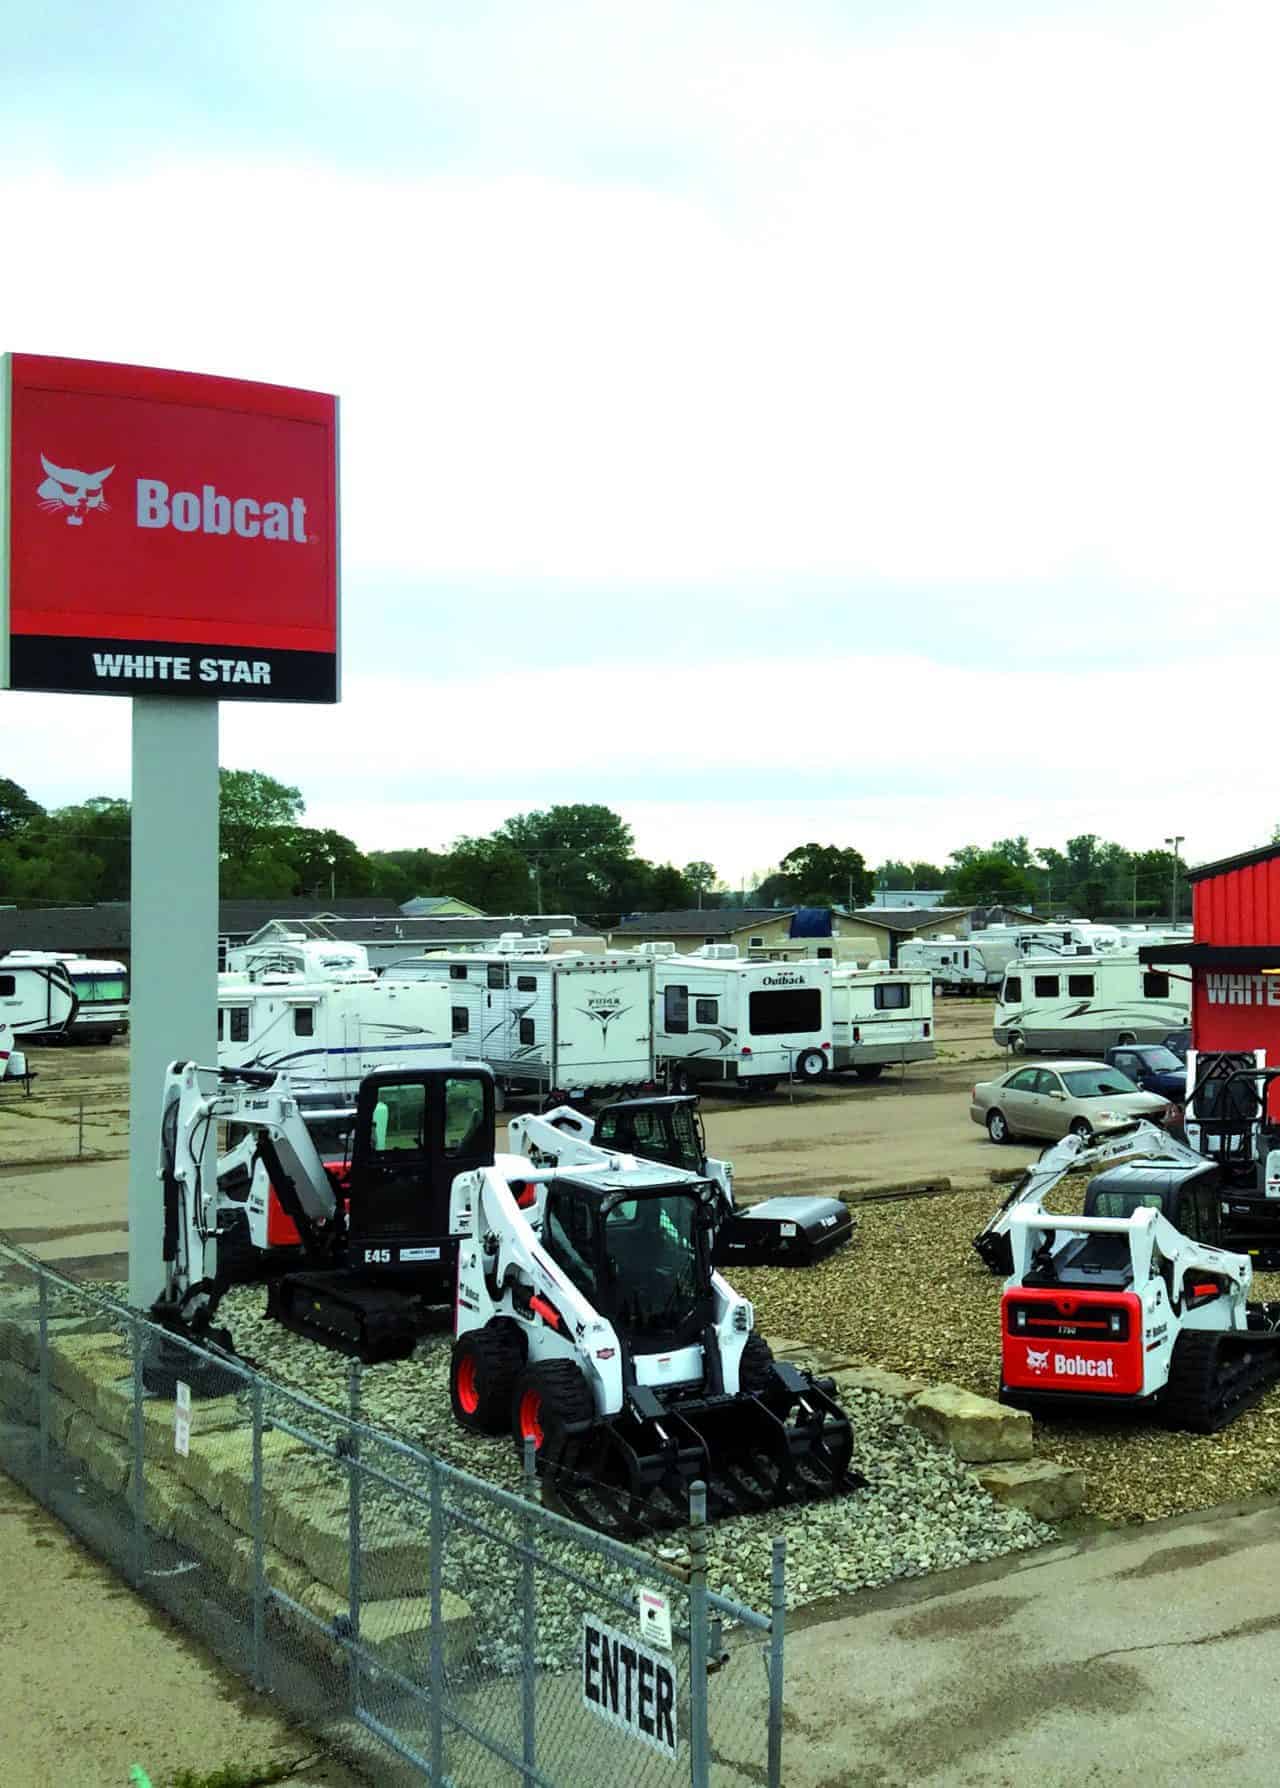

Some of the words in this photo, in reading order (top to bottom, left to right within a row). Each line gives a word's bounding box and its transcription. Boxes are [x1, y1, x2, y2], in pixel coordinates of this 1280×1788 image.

[136, 478, 308, 544] Bobcat
[92, 653, 191, 681] WHITE
[199, 658, 271, 685] STAR
[762, 975, 806, 986] Outback
[364, 1248, 391, 1264] E45
[1054, 1354, 1114, 1378] Bobcat
[585, 1625, 675, 1749] ENTER
